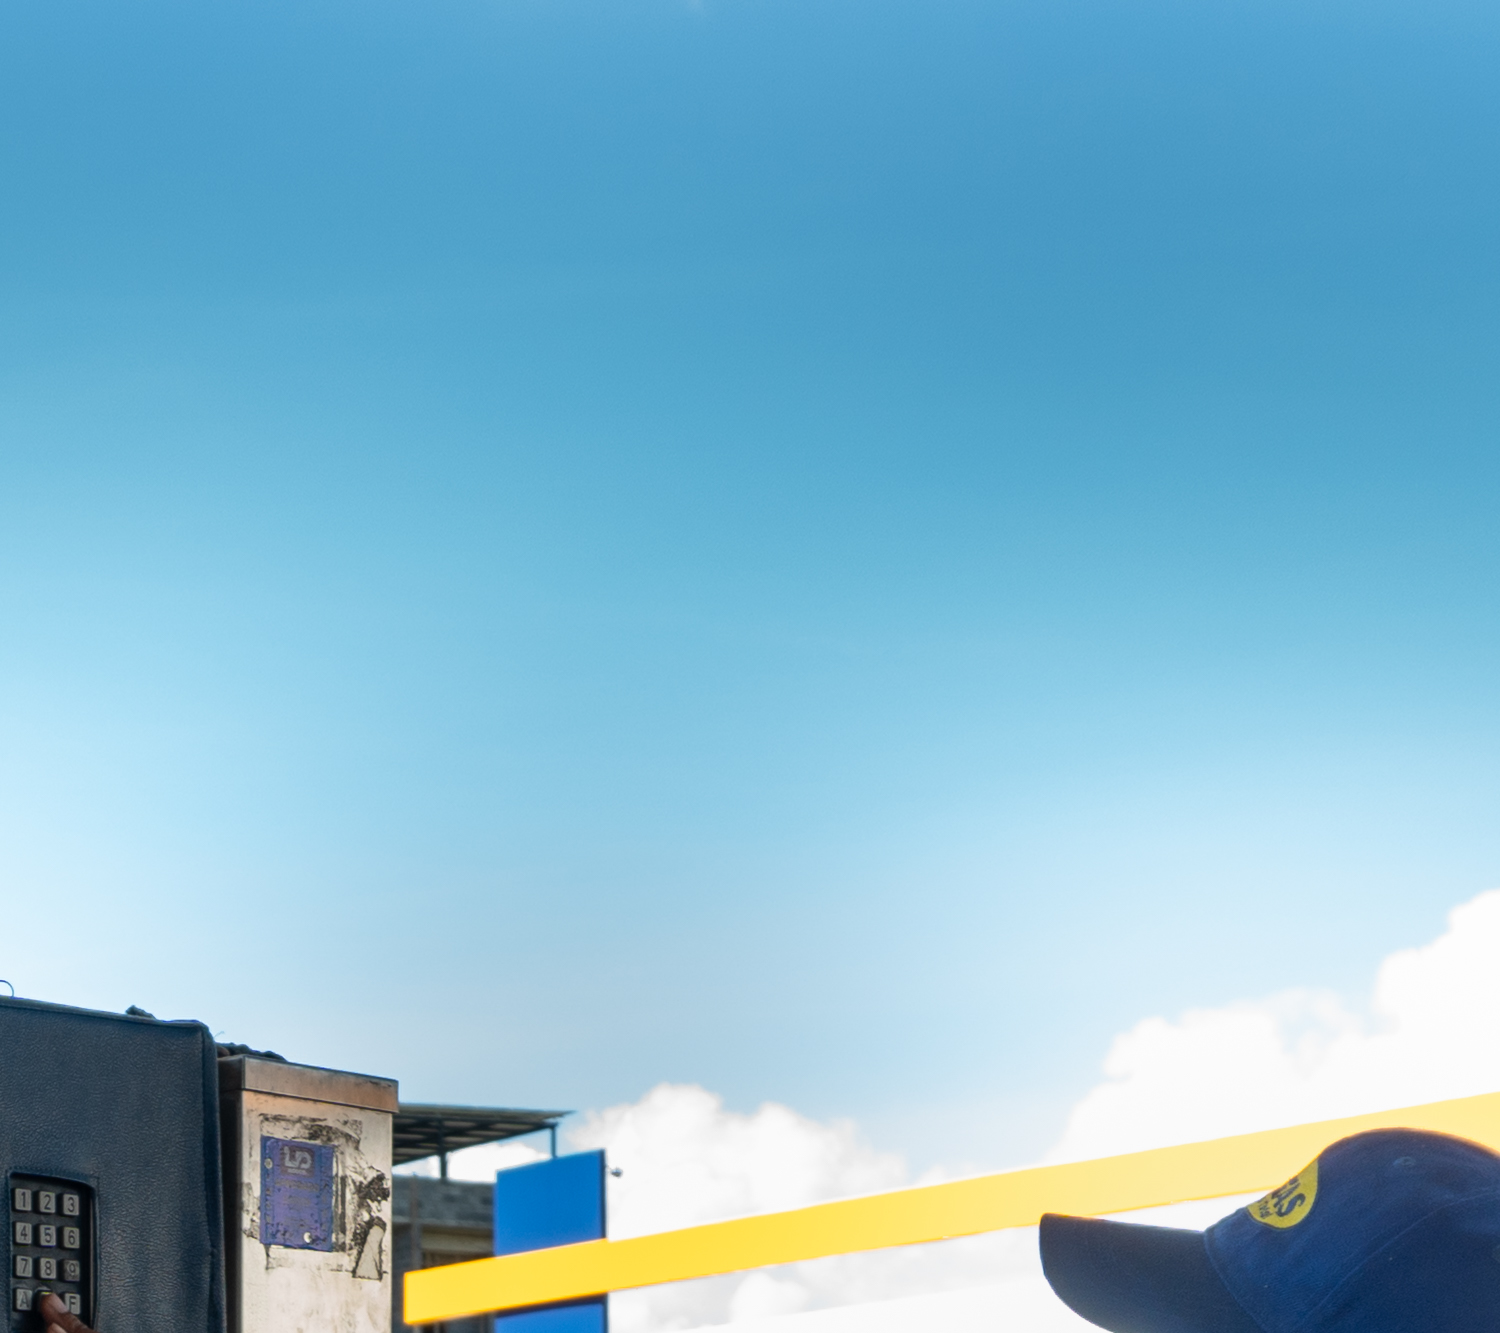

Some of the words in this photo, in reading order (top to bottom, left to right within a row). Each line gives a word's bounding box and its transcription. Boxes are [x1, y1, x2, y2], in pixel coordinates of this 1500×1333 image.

[20, 1191, 27, 1208] 1
[43, 1194, 51, 1210] 2
[67, 1197, 75, 1213] 3
[20, 1225, 28, 1241] 4
[44, 1228, 51, 1243] 5
[68, 1230, 76, 1245] 6
[20, 1258, 28, 1274] 7
[44, 1261, 52, 1276] 8
[19, 1292, 28, 1308] A
[69, 1296, 76, 1310] F
